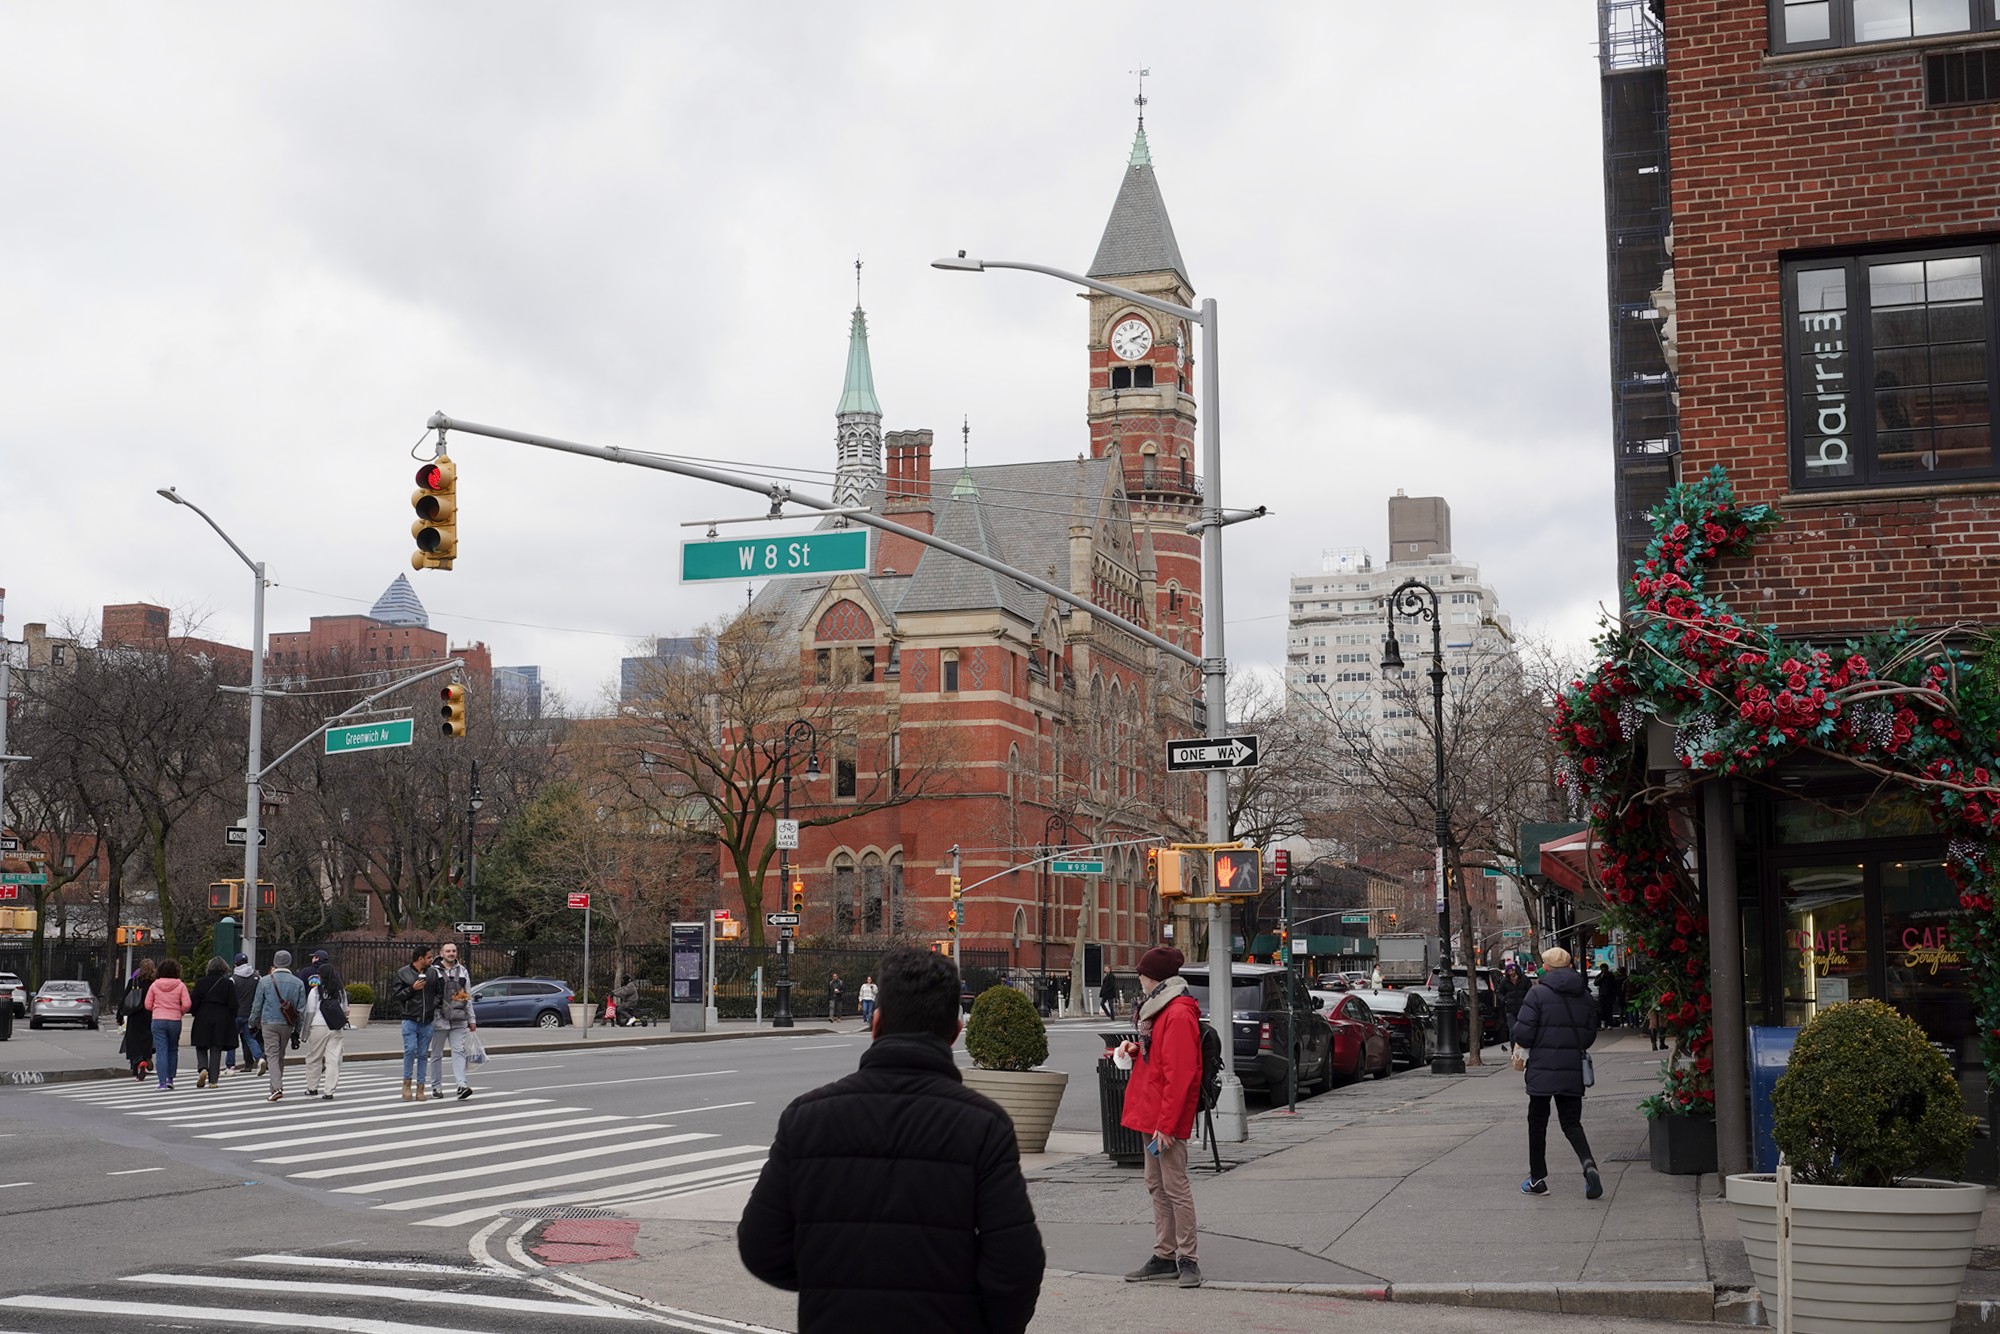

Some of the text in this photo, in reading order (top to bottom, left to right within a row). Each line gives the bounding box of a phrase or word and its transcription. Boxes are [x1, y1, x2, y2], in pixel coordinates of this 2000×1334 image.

[739, 542, 811, 571] W 8 St
[345, 728, 389, 745] Greenwich Av
[1180, 745, 1244, 761] ONE WAY
[232, 831, 244, 840] ONE
[1902, 926, 1953, 950] CAF
